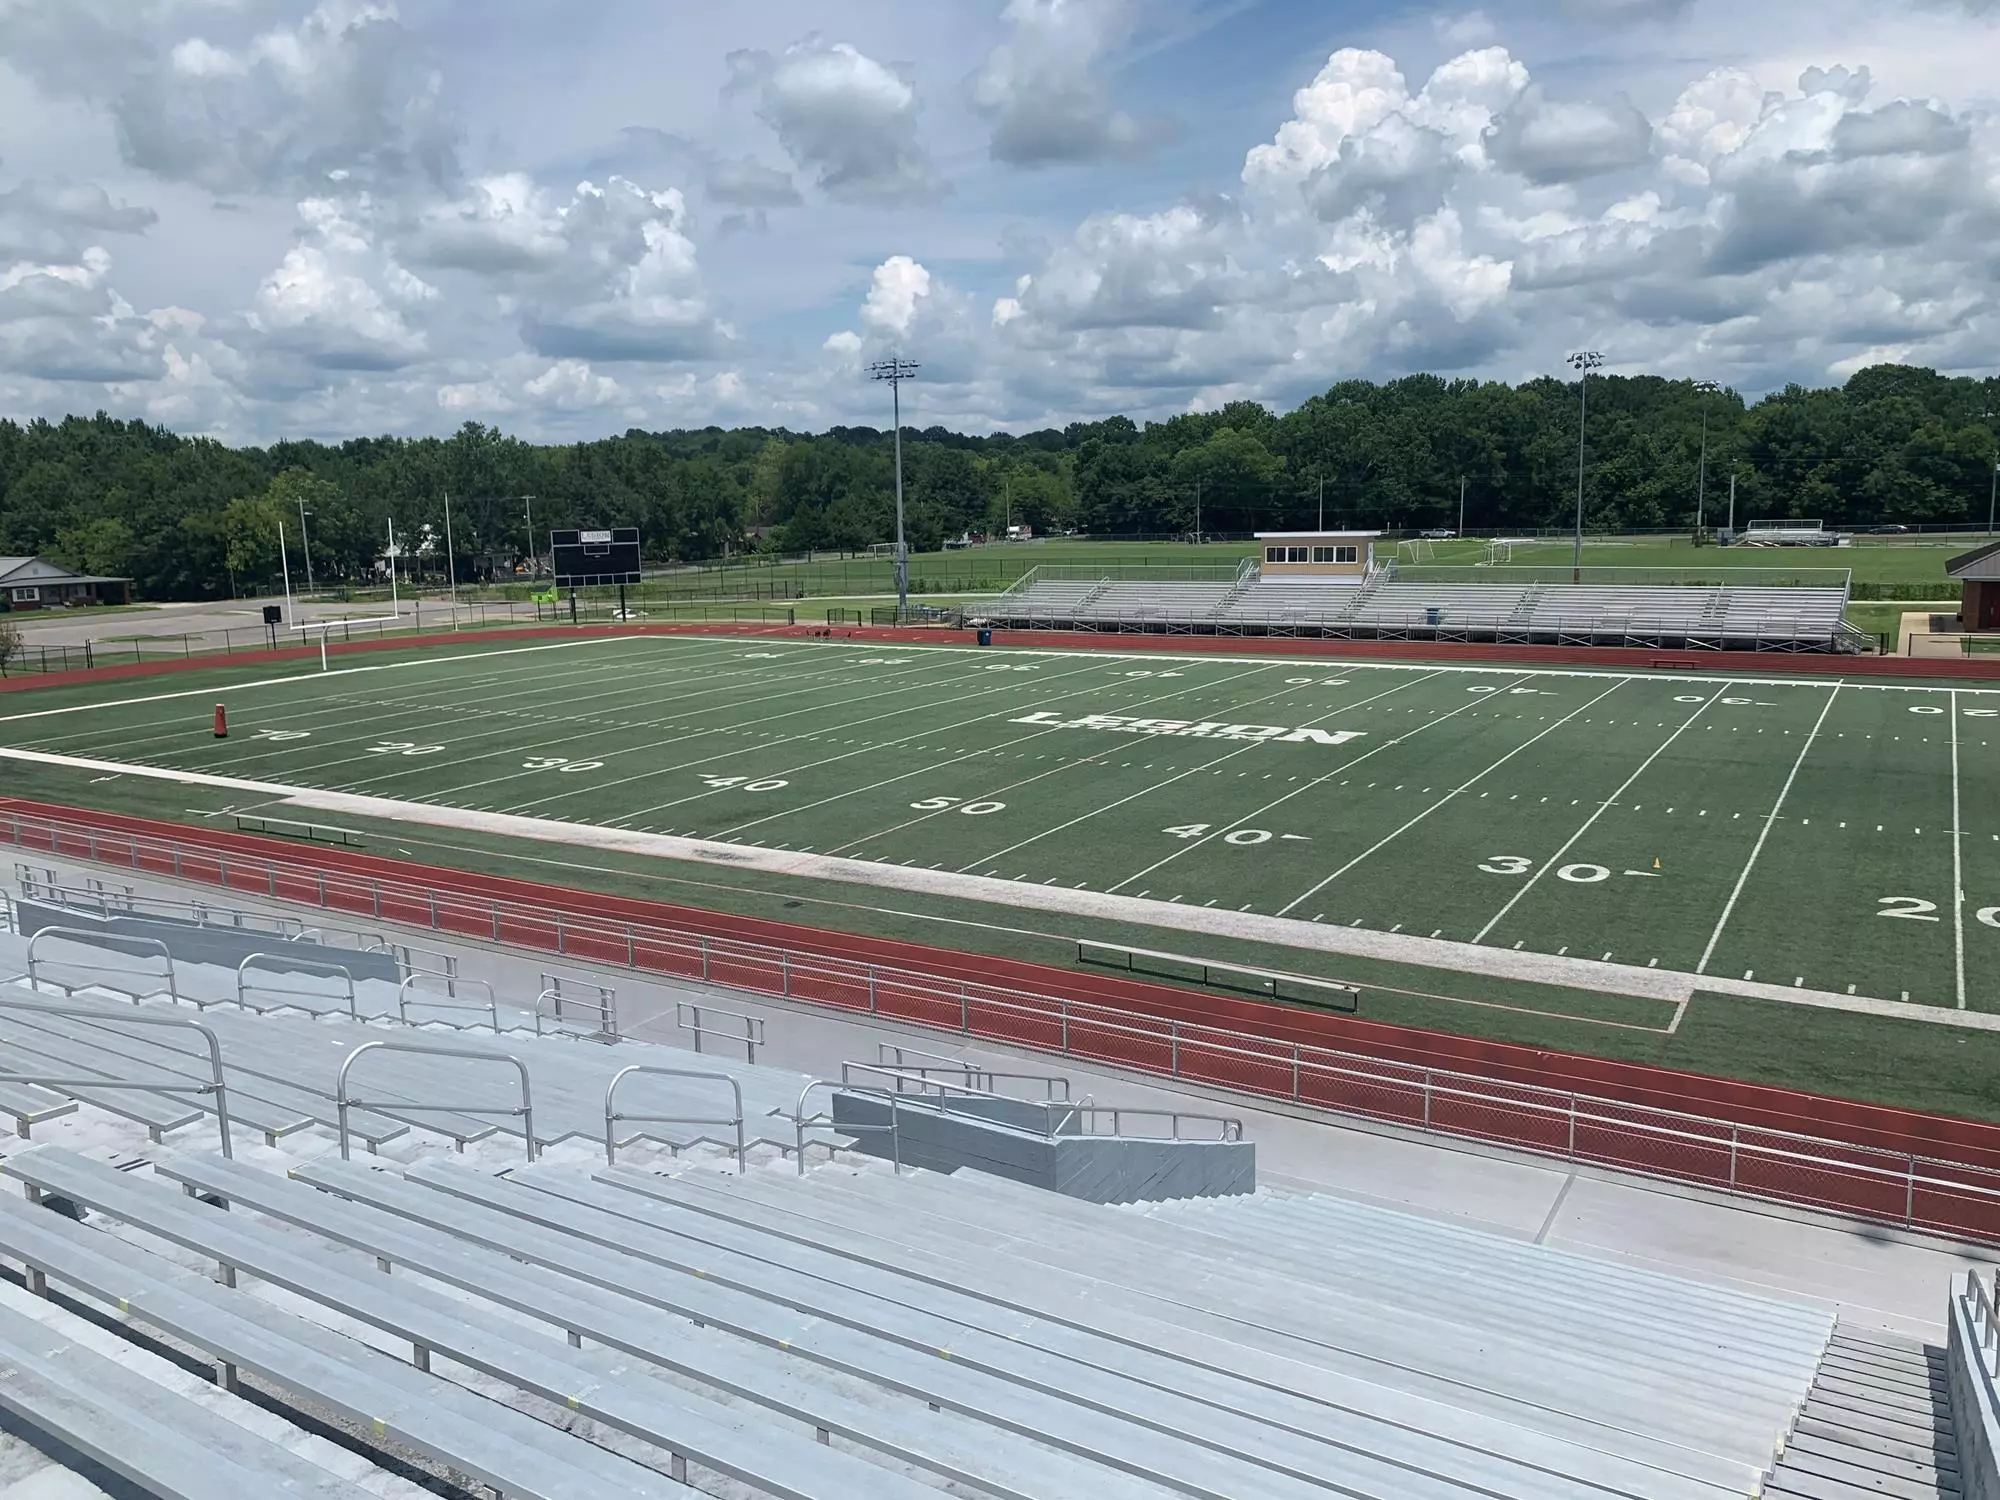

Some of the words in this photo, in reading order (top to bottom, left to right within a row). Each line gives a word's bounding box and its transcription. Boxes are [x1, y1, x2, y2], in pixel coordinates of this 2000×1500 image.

[1285, 678, 1350, 686] 50
[1466, 686, 1538, 694] 40
[1673, 696, 1752, 705] 30
[1007, 712, 1368, 744] LEGION
[1054, 723, 1271, 741] STADIUM
[365, 742, 446, 755] 20
[522, 757, 604, 772] 30
[702, 776, 789, 791] 40
[910, 796, 1006, 815] 50
[1161, 823, 1273, 845] 40
[1477, 856, 1611, 882] 30
